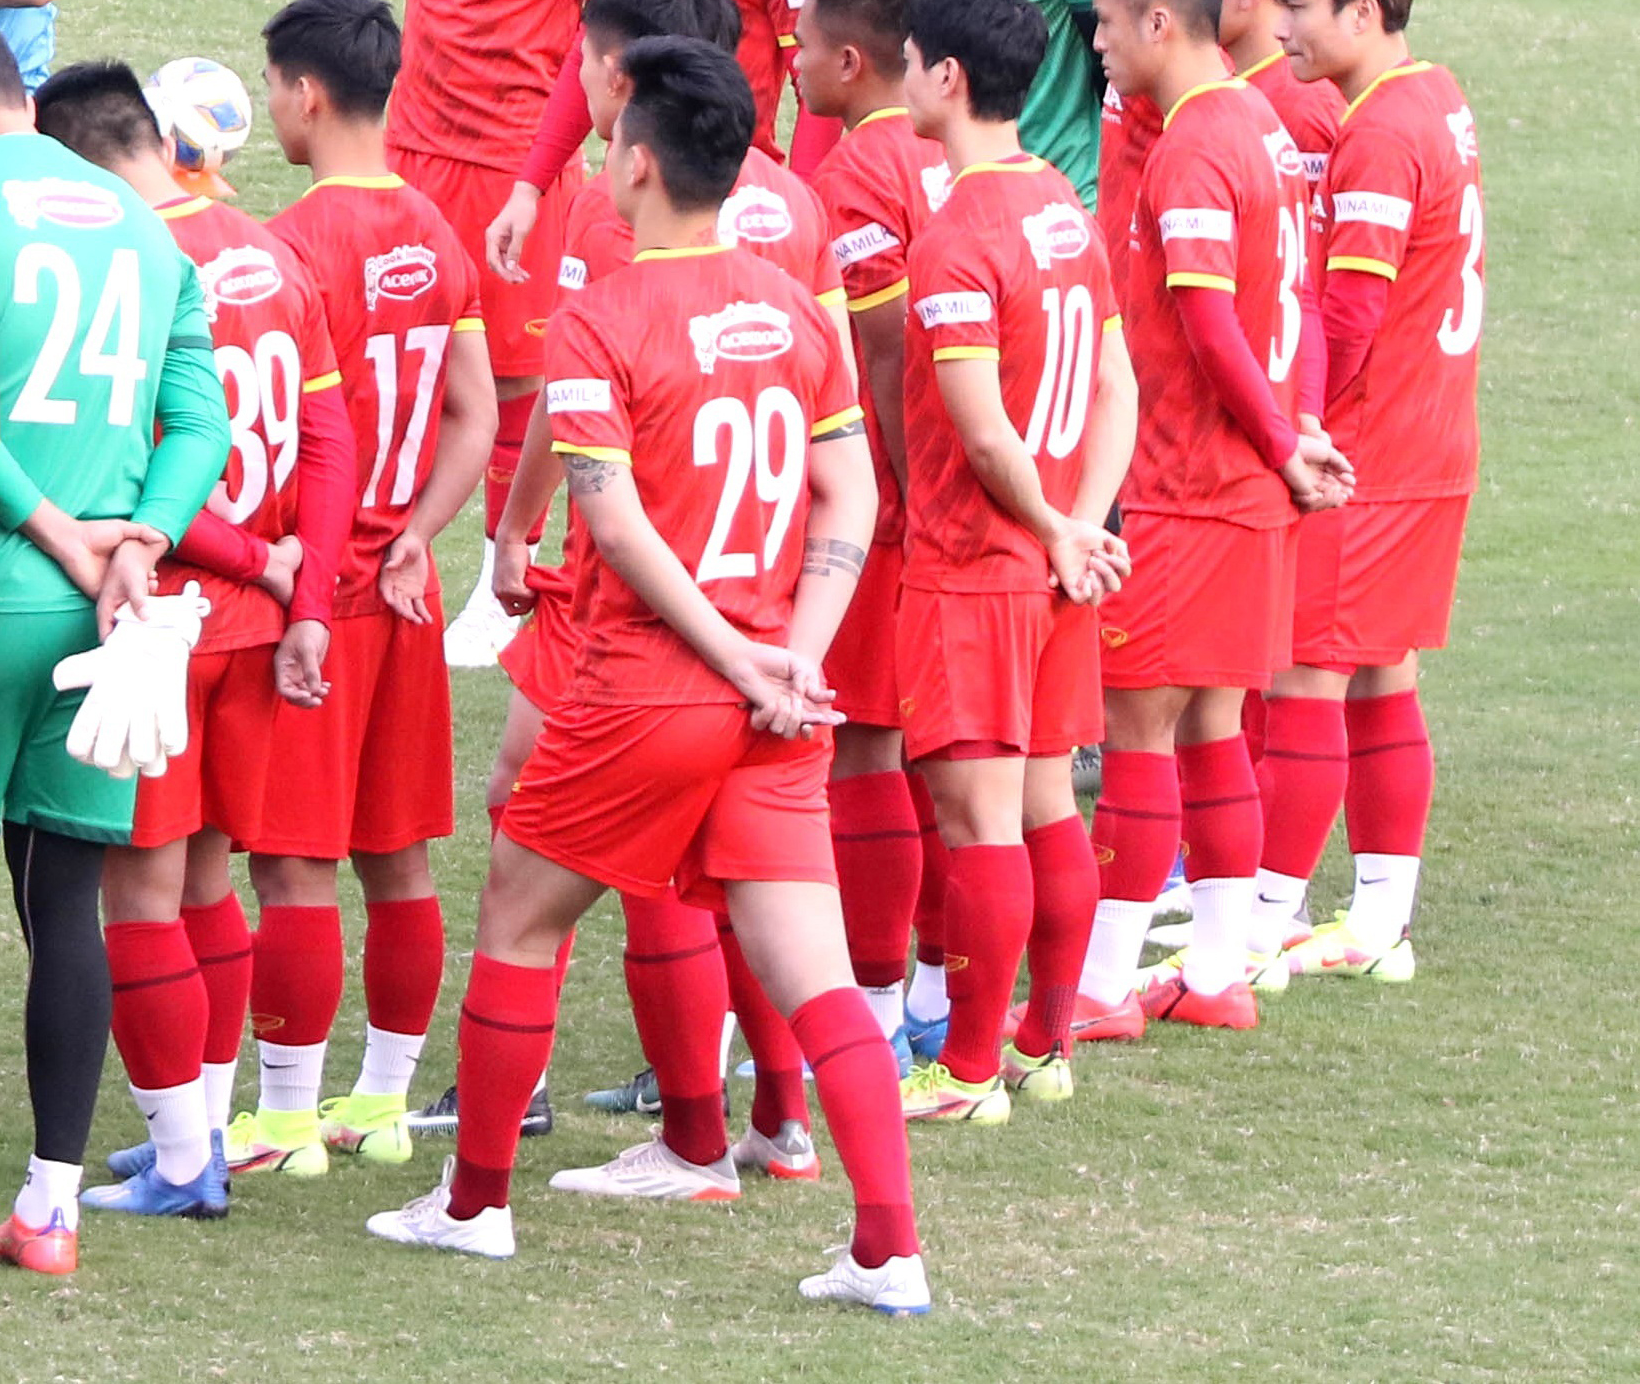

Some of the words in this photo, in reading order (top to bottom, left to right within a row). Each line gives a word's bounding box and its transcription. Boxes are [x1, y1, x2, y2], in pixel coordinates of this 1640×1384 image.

[8, 241, 148, 427] 24
[362, 324, 451, 508] 17
[1023, 284, 1094, 460] 10
[692, 386, 806, 584] 29
